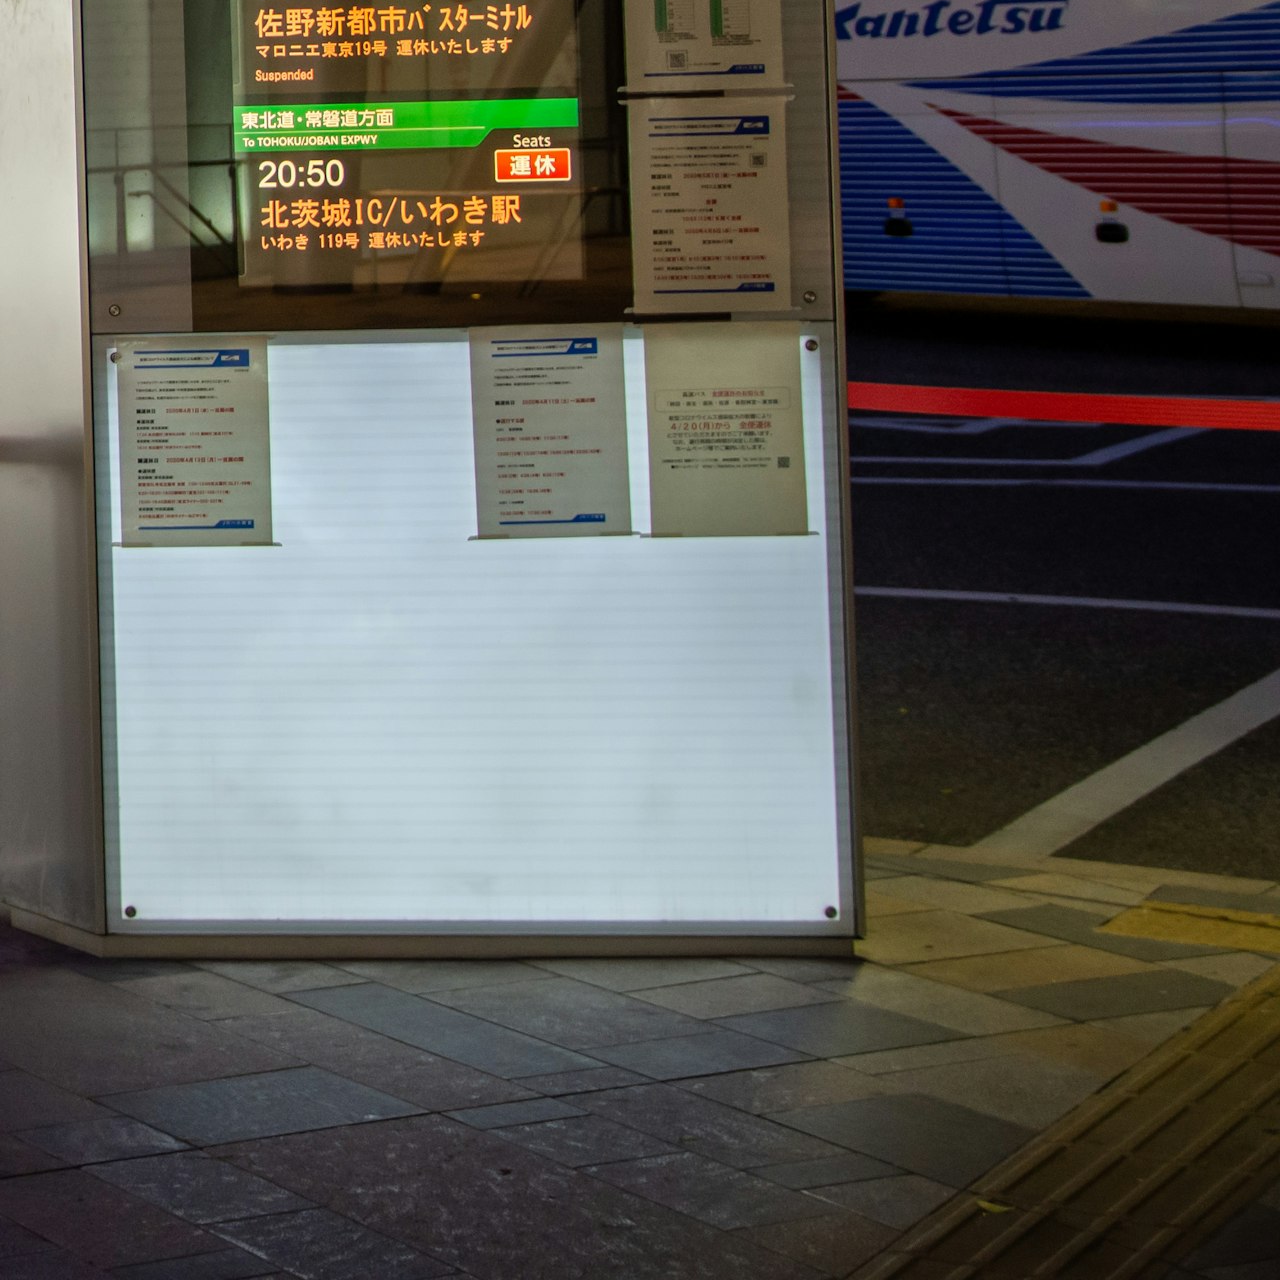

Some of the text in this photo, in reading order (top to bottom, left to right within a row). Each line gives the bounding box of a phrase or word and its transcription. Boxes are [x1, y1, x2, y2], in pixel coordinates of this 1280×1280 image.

[255, 37, 514, 59] マロニエ東京19号 運休いたします
[255, 68, 315, 83] Suspended
[241, 108, 395, 129] 東北道・常磐道方面
[242, 134, 379, 148] To TOHOKU/JOBAN EXPWY
[512, 133, 552, 149] Seats
[257, 158, 345, 189] 20:50
[509, 154, 557, 177] 運休
[260, 194, 522, 228] 北茨城IC/いわき駅
[260, 229, 486, 252] いわき 119号 運休いたします
